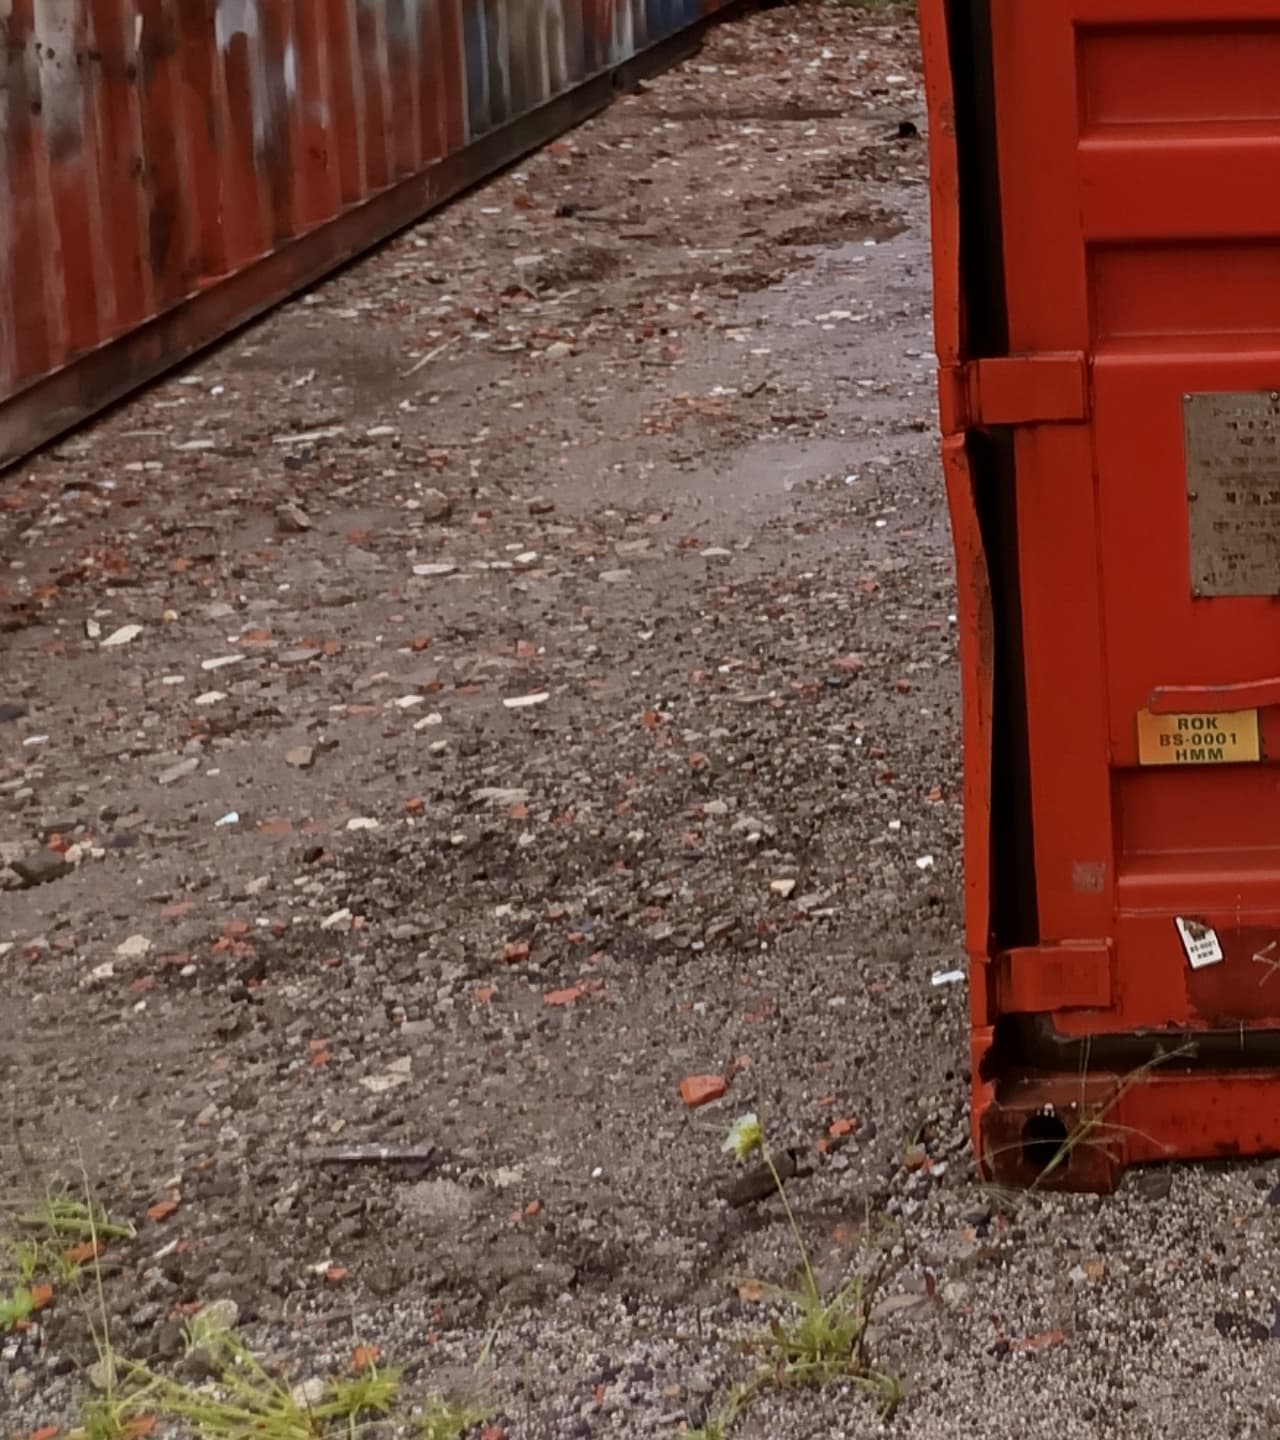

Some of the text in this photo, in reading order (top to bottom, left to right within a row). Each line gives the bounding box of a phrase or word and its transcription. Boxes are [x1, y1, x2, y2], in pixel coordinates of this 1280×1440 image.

[1177, 717, 1219, 731] ROK
[1159, 733, 1237, 747] BS-0001
[1175, 748, 1224, 761] HMM
